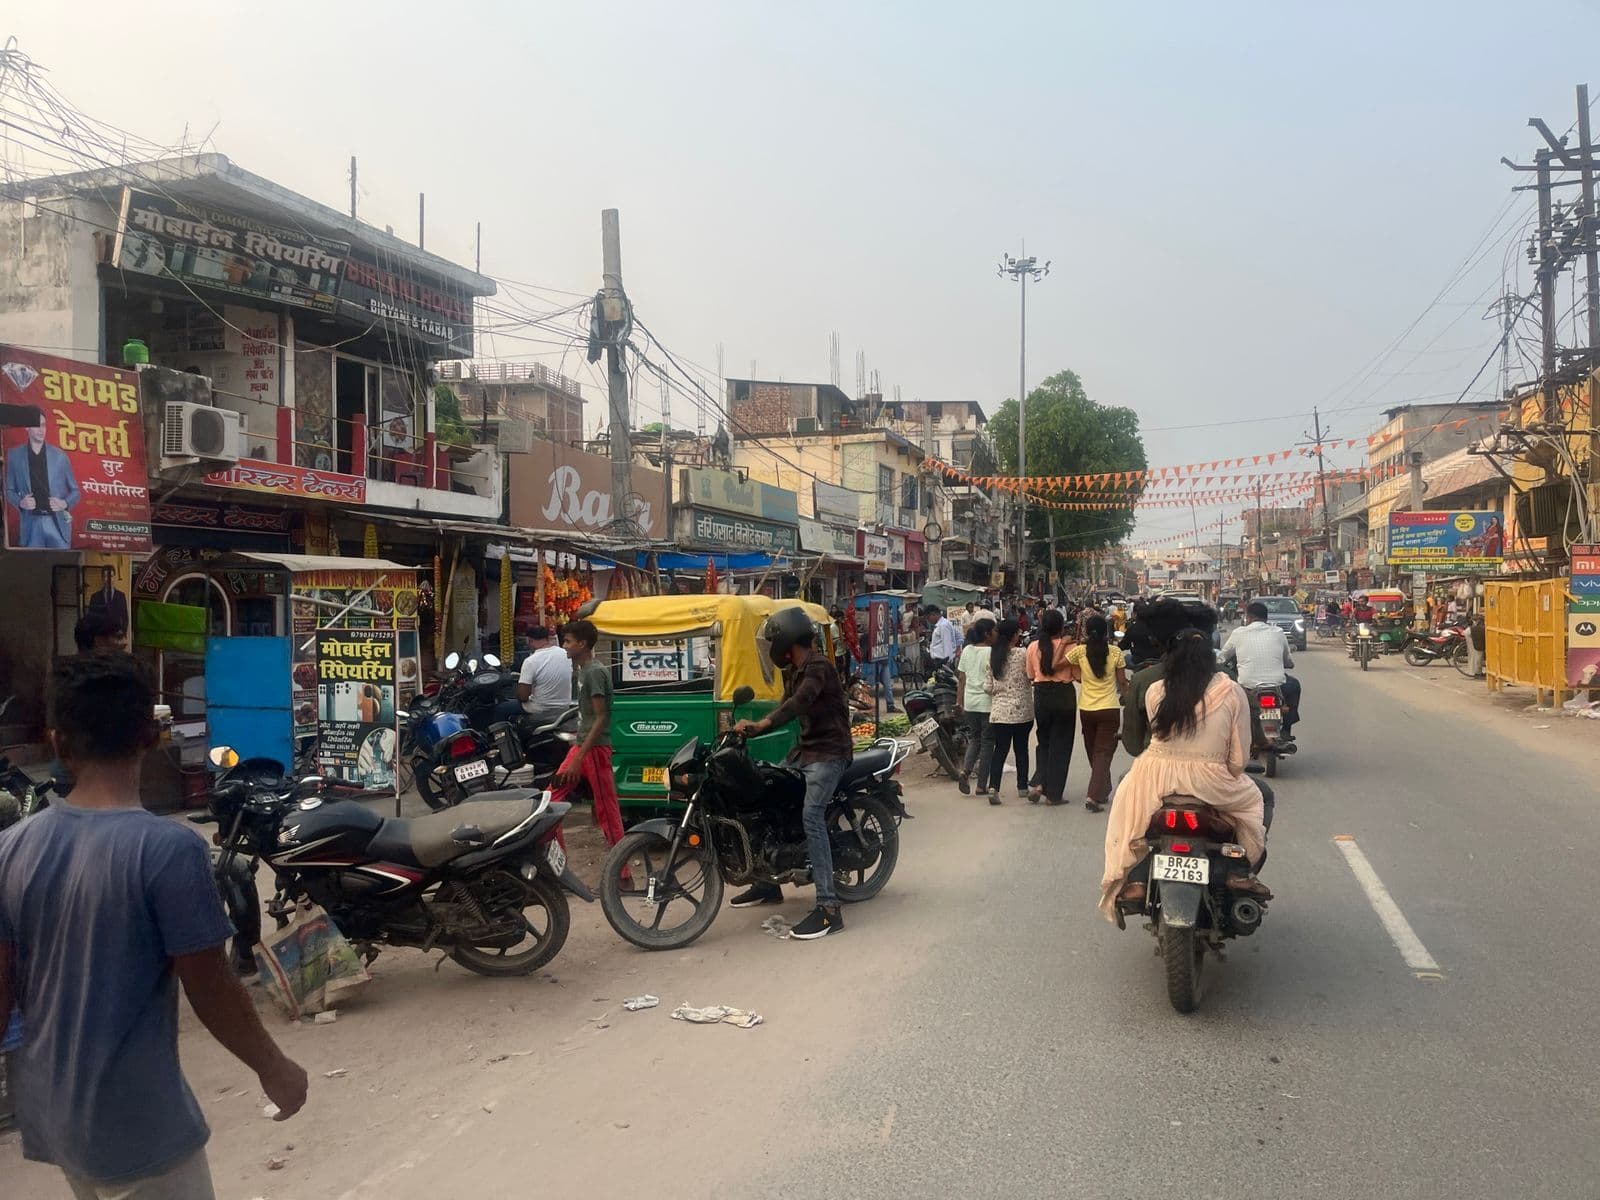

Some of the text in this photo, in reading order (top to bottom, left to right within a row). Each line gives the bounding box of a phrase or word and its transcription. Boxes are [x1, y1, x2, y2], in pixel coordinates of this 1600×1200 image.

[370, 298, 410, 324] BIRYANI
[421, 318, 453, 340] KABAB
[41, 368, 138, 414] डायमंड
[53, 408, 131, 458] टेलर्स
[82, 478, 146, 498] स्पेशलिस्ट
[302, 472, 366, 499] टेलर्स
[542, 465, 653, 534] Baa
[320, 638, 392, 659] मोबाईल
[319, 660, 393, 681] रिपेयरिंग
[1164, 868, 1203, 881] Z2163
[1168, 857, 1199, 869] BR43
